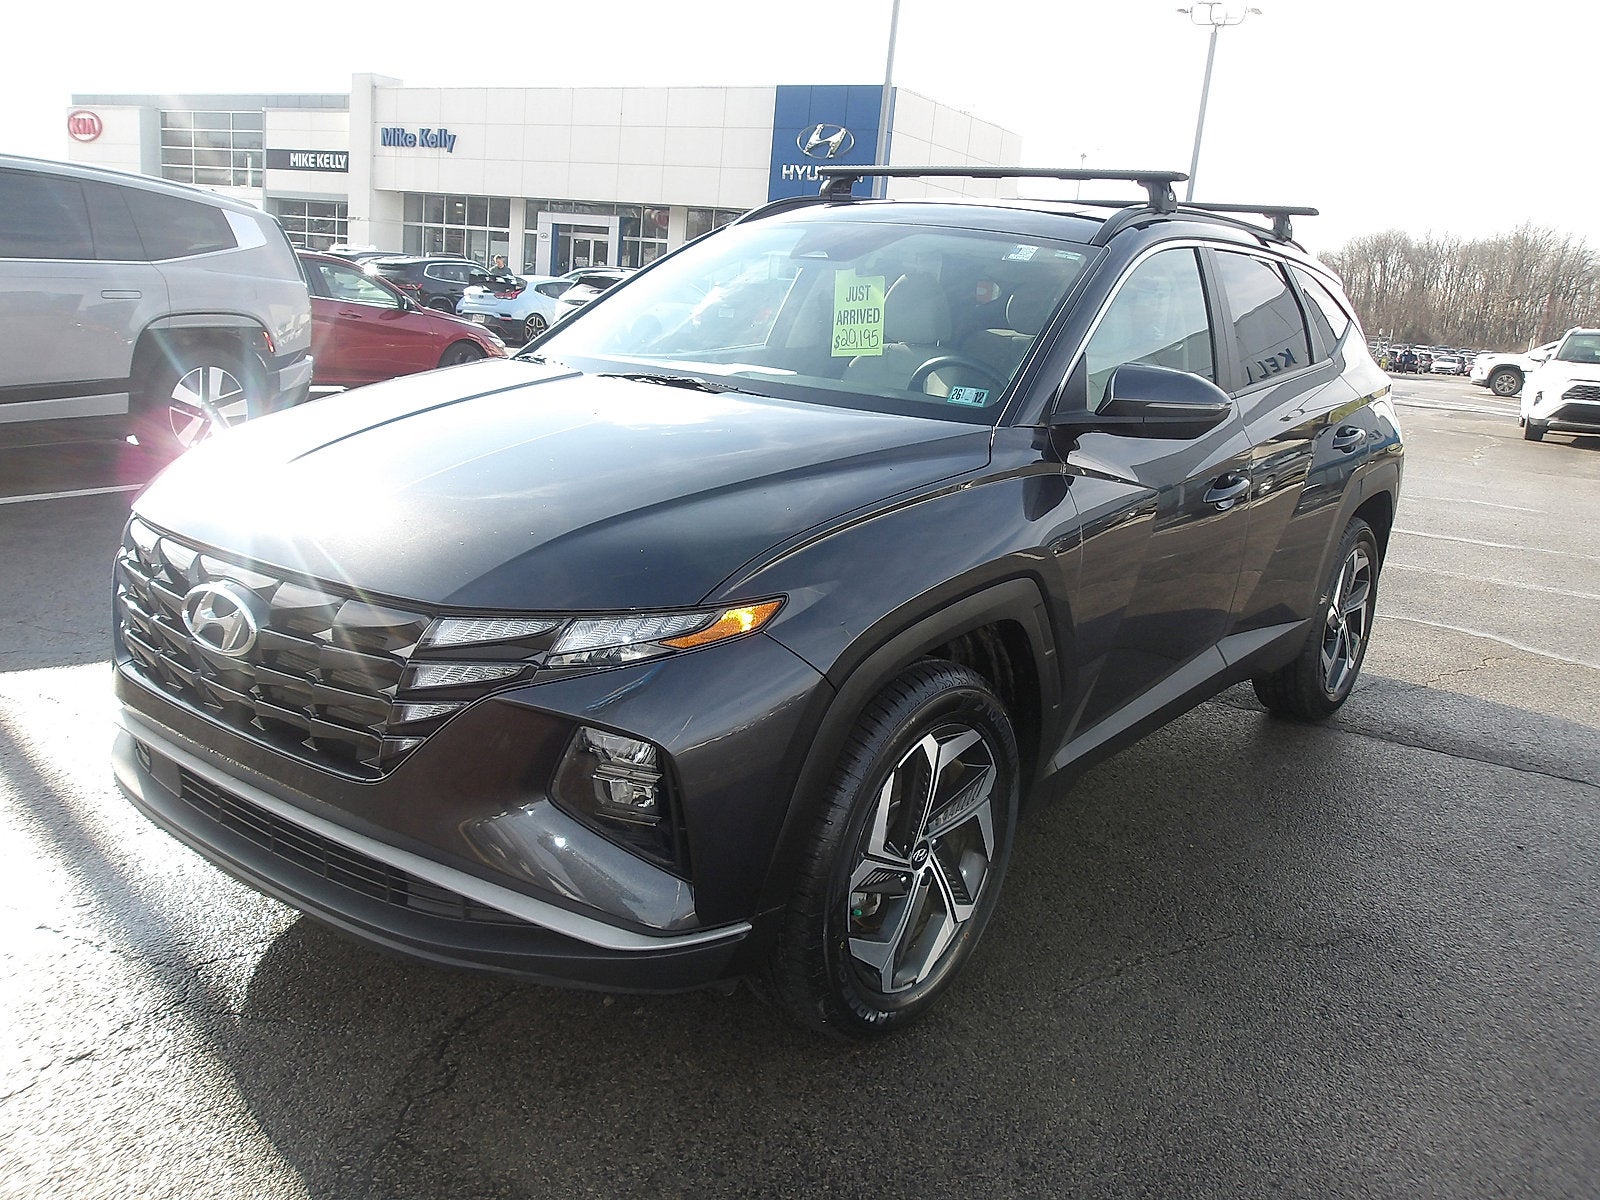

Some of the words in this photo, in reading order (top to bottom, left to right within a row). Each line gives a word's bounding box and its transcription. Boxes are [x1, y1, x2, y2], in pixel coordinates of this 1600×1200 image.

[70, 117, 98, 136] KIA
[380, 127, 417, 148] Mike
[418, 127, 457, 154] Kelly
[289, 152, 315, 168] MIKE
[316, 153, 347, 169] KELLY
[845, 284, 872, 303] JUST
[836, 307, 881, 326] ARRIVED
[973, 391, 985, 404] 12
